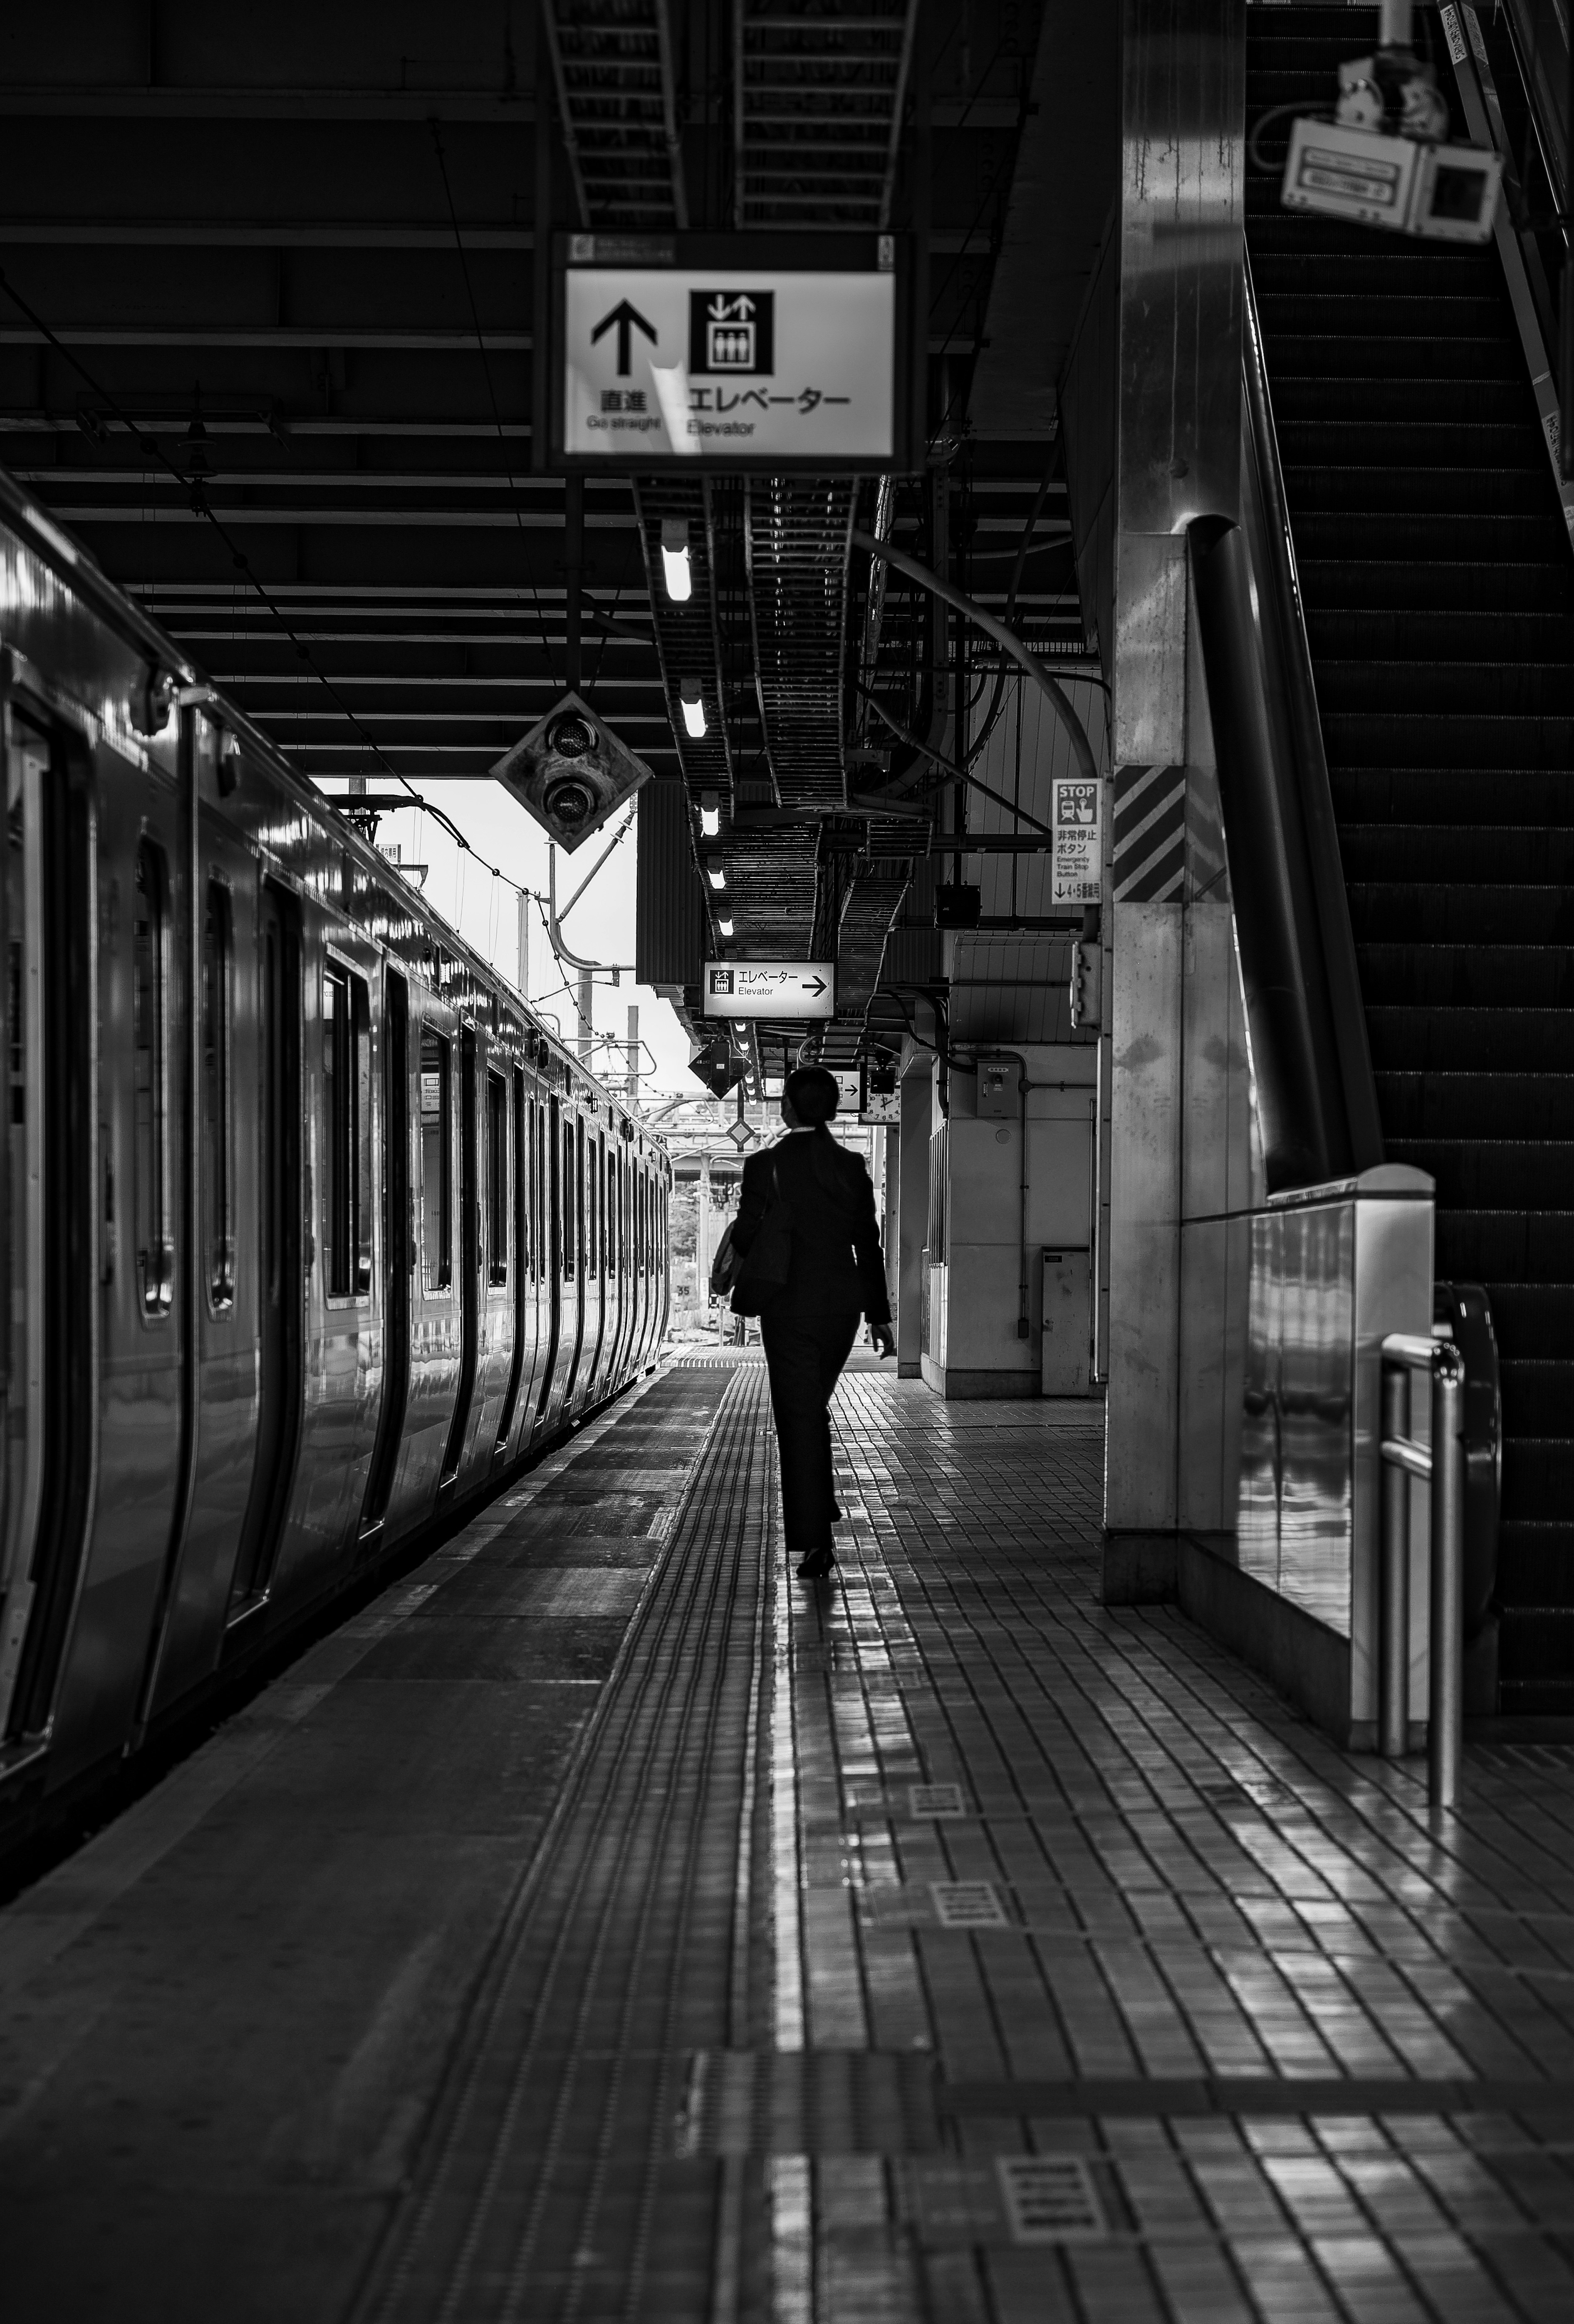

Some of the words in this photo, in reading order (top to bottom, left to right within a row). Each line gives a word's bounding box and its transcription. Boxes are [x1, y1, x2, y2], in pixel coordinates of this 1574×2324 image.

[601, 389, 647, 411] 直進
[688, 386, 851, 414] エレベーター
[586, 415, 609, 430] Go
[610, 416, 661, 434] straight
[686, 419, 756, 437] Elevator
[1060, 786, 1094, 797] STOP
[1057, 830, 1098, 841] 非常停止
[1057, 843, 1086, 854] ボタン
[738, 970, 798, 984] エレベーター
[739, 987, 774, 995] Elevator
[677, 1286, 690, 1296] 35
